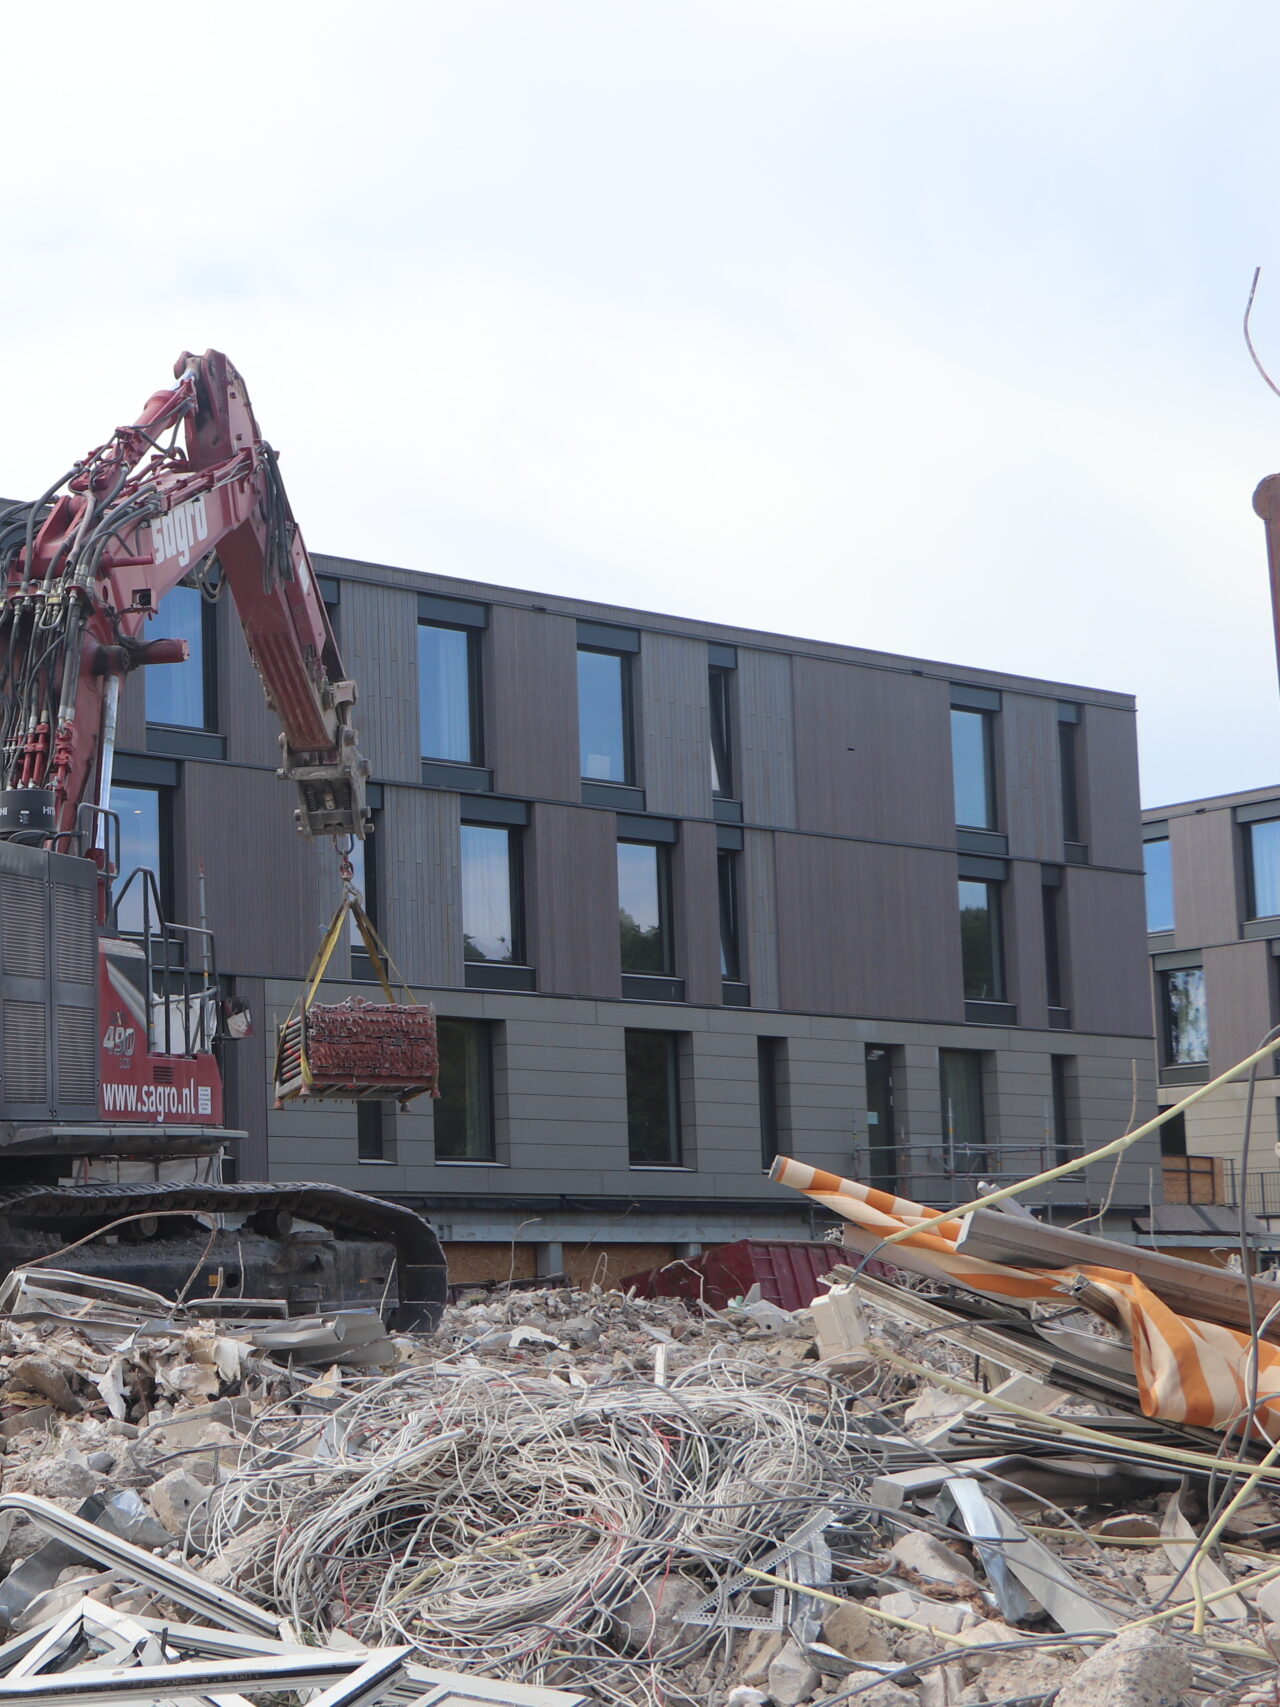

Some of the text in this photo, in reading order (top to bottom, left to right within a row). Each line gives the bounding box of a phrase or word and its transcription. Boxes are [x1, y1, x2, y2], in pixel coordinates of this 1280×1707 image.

[151, 496, 208, 567] sagro
[102, 1025, 136, 1057] 490
[102, 1078, 196, 1122] www.sagro.nl
